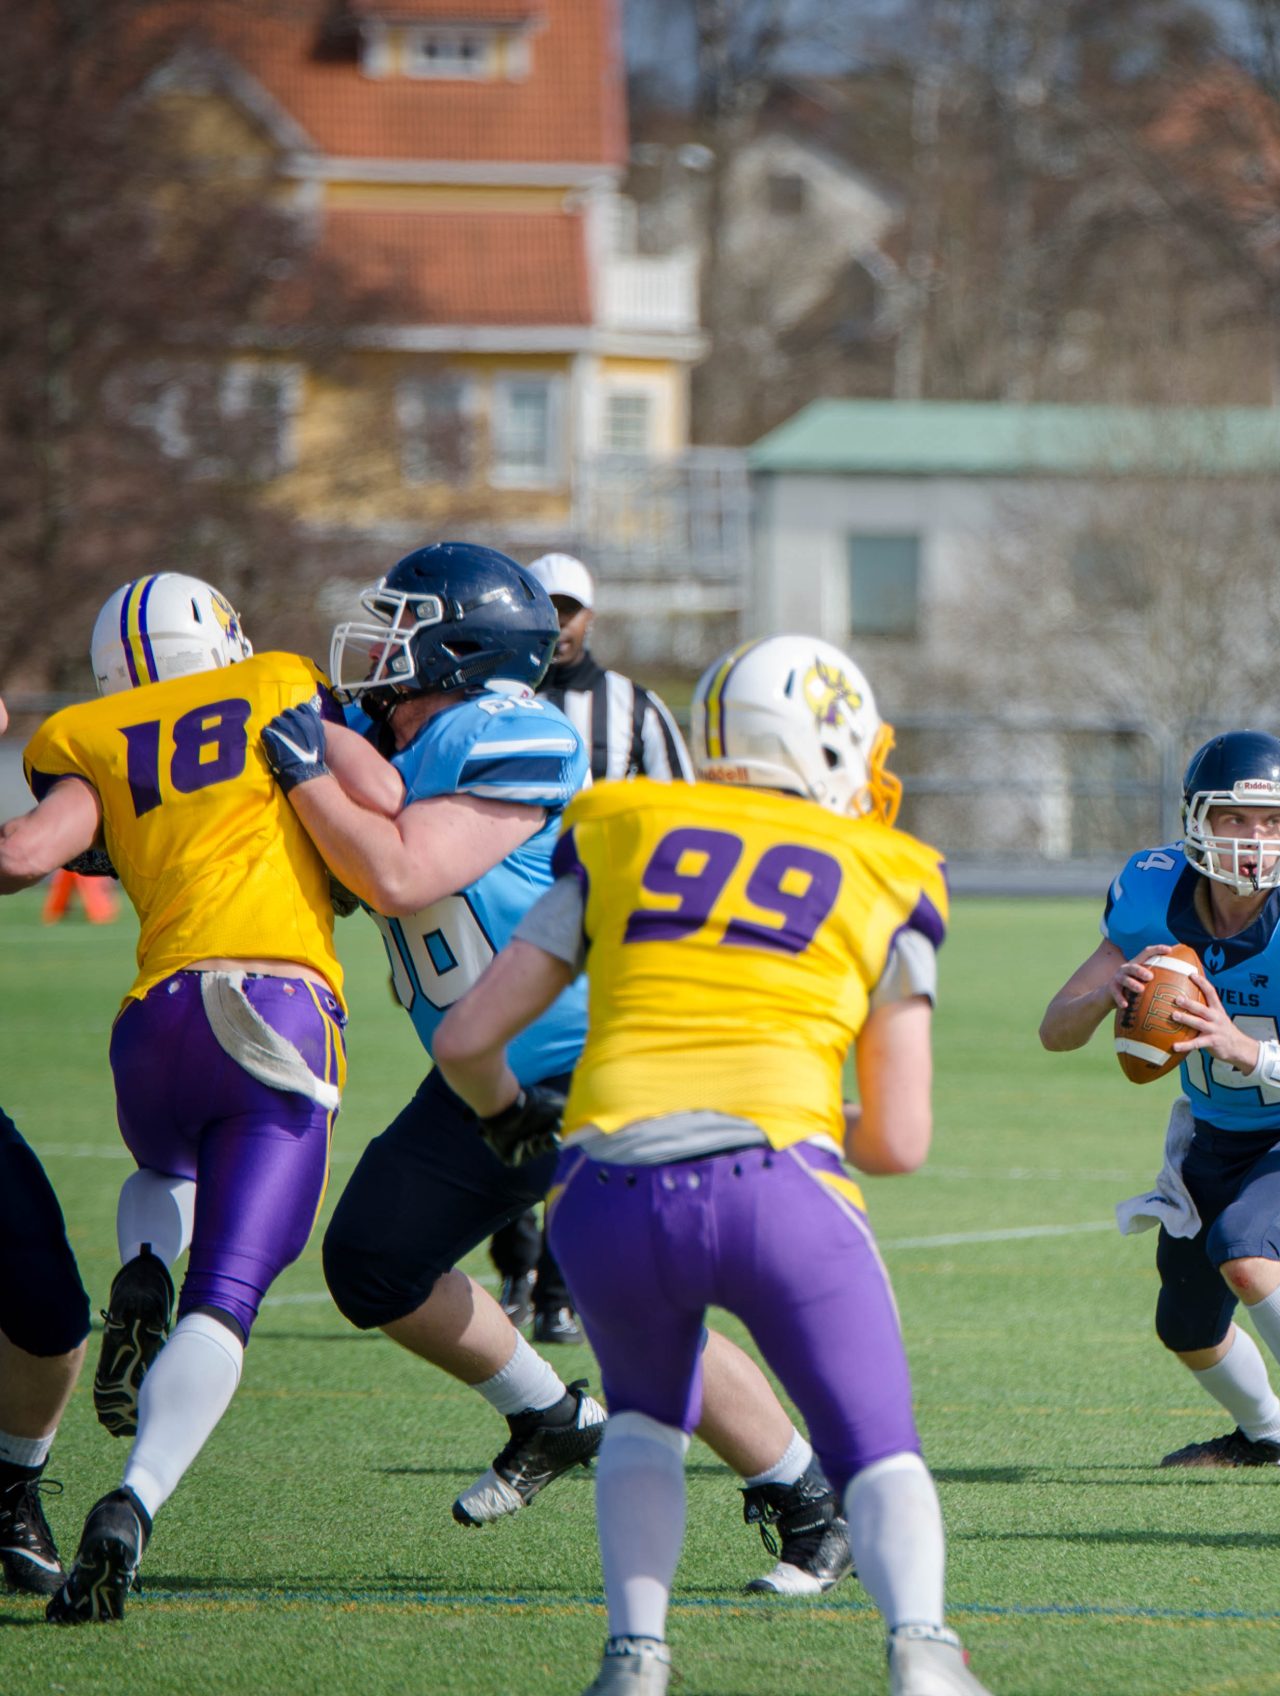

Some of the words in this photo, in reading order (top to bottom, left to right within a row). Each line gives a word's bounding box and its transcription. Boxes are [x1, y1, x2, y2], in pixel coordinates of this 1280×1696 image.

[117, 698, 252, 819] 18
[623, 827, 843, 956] 99
[1216, 987, 1260, 1007] VELS
